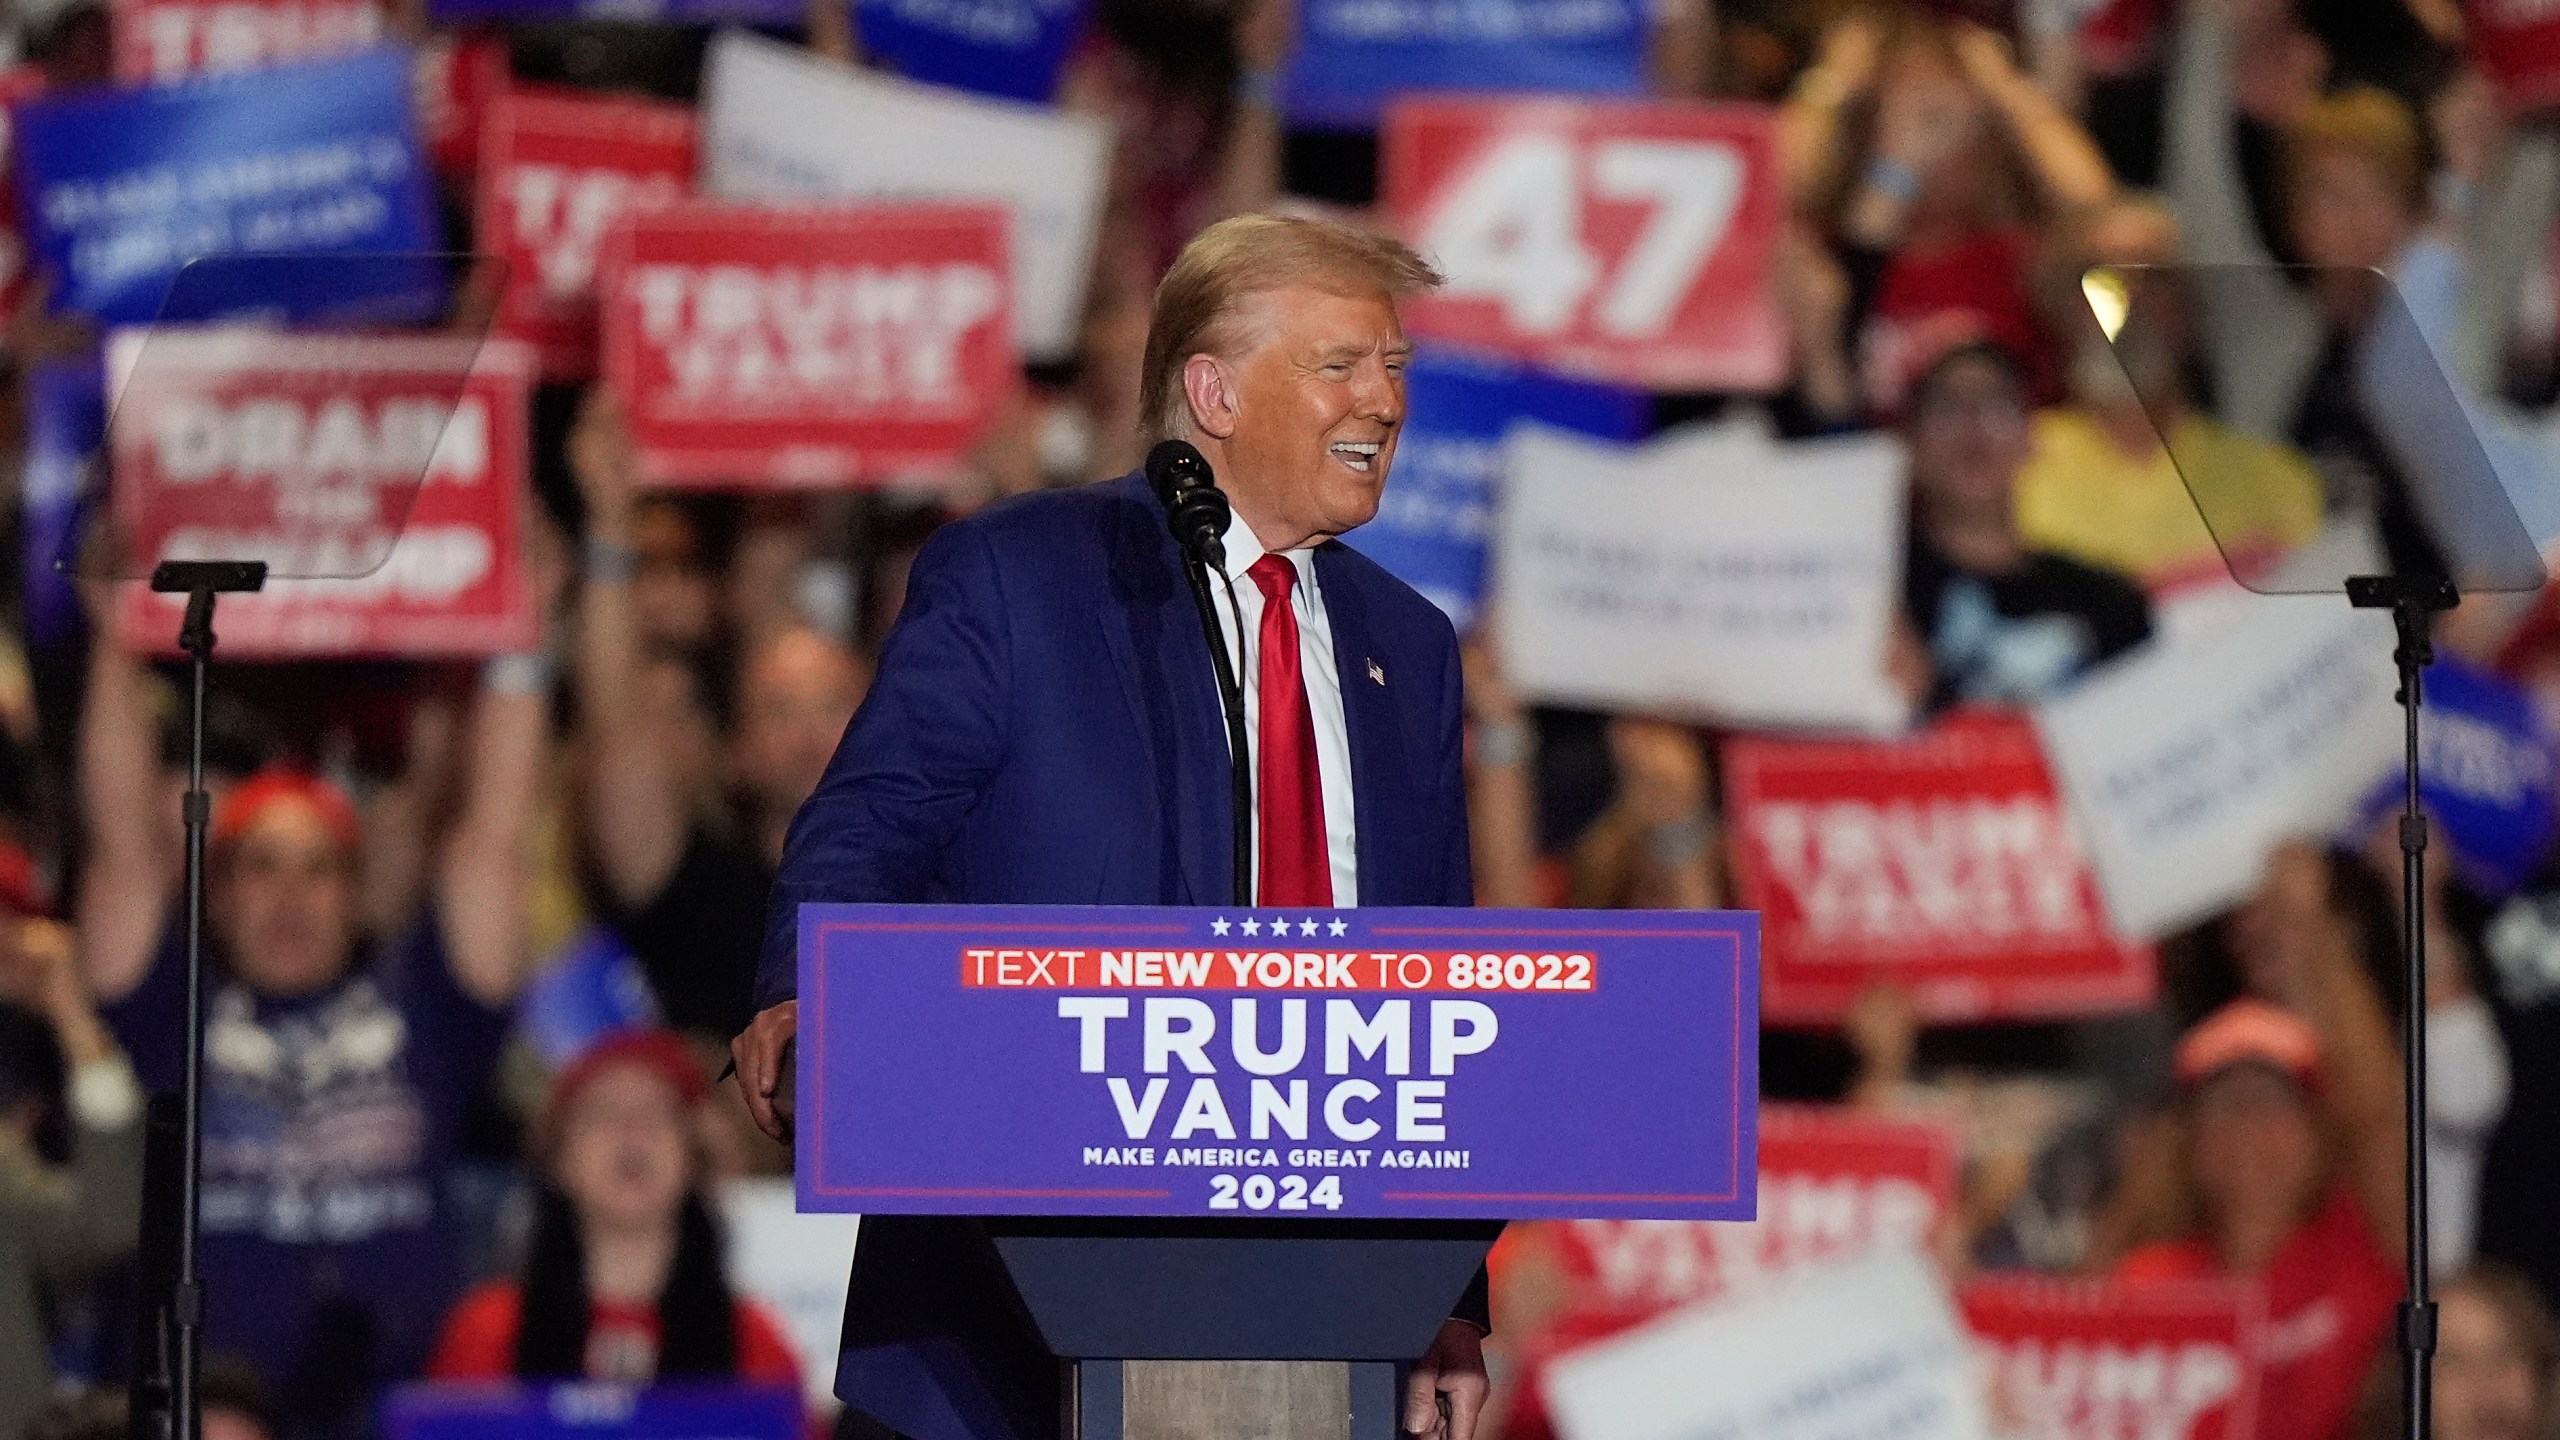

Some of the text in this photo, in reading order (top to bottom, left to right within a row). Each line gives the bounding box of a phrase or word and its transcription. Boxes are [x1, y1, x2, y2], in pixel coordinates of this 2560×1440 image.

[1418, 132, 1746, 338] 47
[638, 265, 999, 339] TRUMP
[156, 398, 486, 481] DRAIN
[1757, 798, 2052, 877] TRUM
[967, 950, 1592, 990] TEXT NEW YORK TO 88022
[1058, 996, 1500, 1076] TRUMP
[1106, 1077, 1447, 1142] VANCE
[1083, 1147, 1471, 1169] MAKE AMERICA GREAT AGAIN!
[1208, 1174, 1344, 1211] 2024
